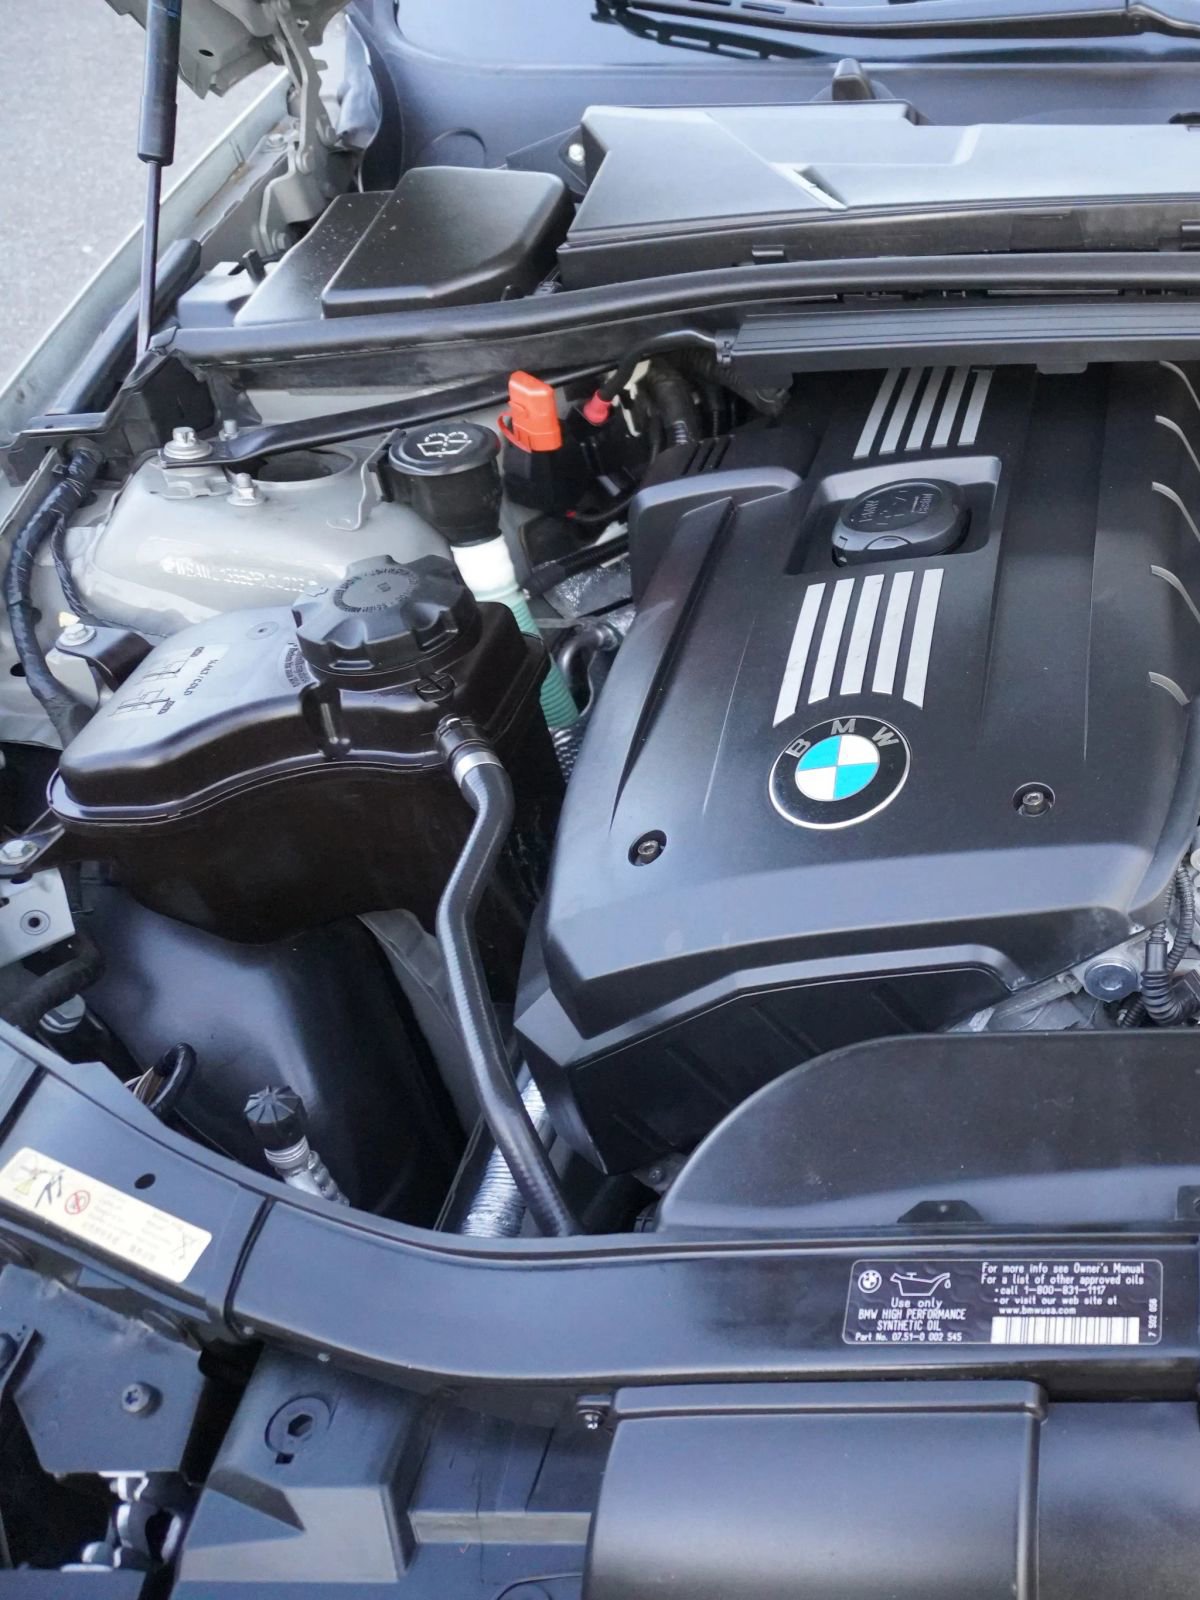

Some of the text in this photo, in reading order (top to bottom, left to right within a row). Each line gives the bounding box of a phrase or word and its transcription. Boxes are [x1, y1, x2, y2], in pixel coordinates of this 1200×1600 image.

[785, 718, 899, 758] BMW
[982, 1262, 1144, 1274] For more info see Owner's Manual
[981, 1273, 1144, 1287] For a list of other approved oils
[1000, 1285, 1018, 1295] call
[890, 1297, 943, 1310] Use only
[1014, 1295, 1036, 1305] visit
[1041, 1297, 1056, 1305] our
[1062, 1295, 1079, 1305] web
[1084, 1295, 1103, 1305] site
[1107, 1295, 1118, 1305] at
[858, 1309, 967, 1320] BMW HIGH PERFORMANCE
[999, 1305, 1077, 1315] www.bmwusa.com
[877, 1320, 941, 1331] SYNTHETIC OIL
[855, 1332, 872, 1341] Part
